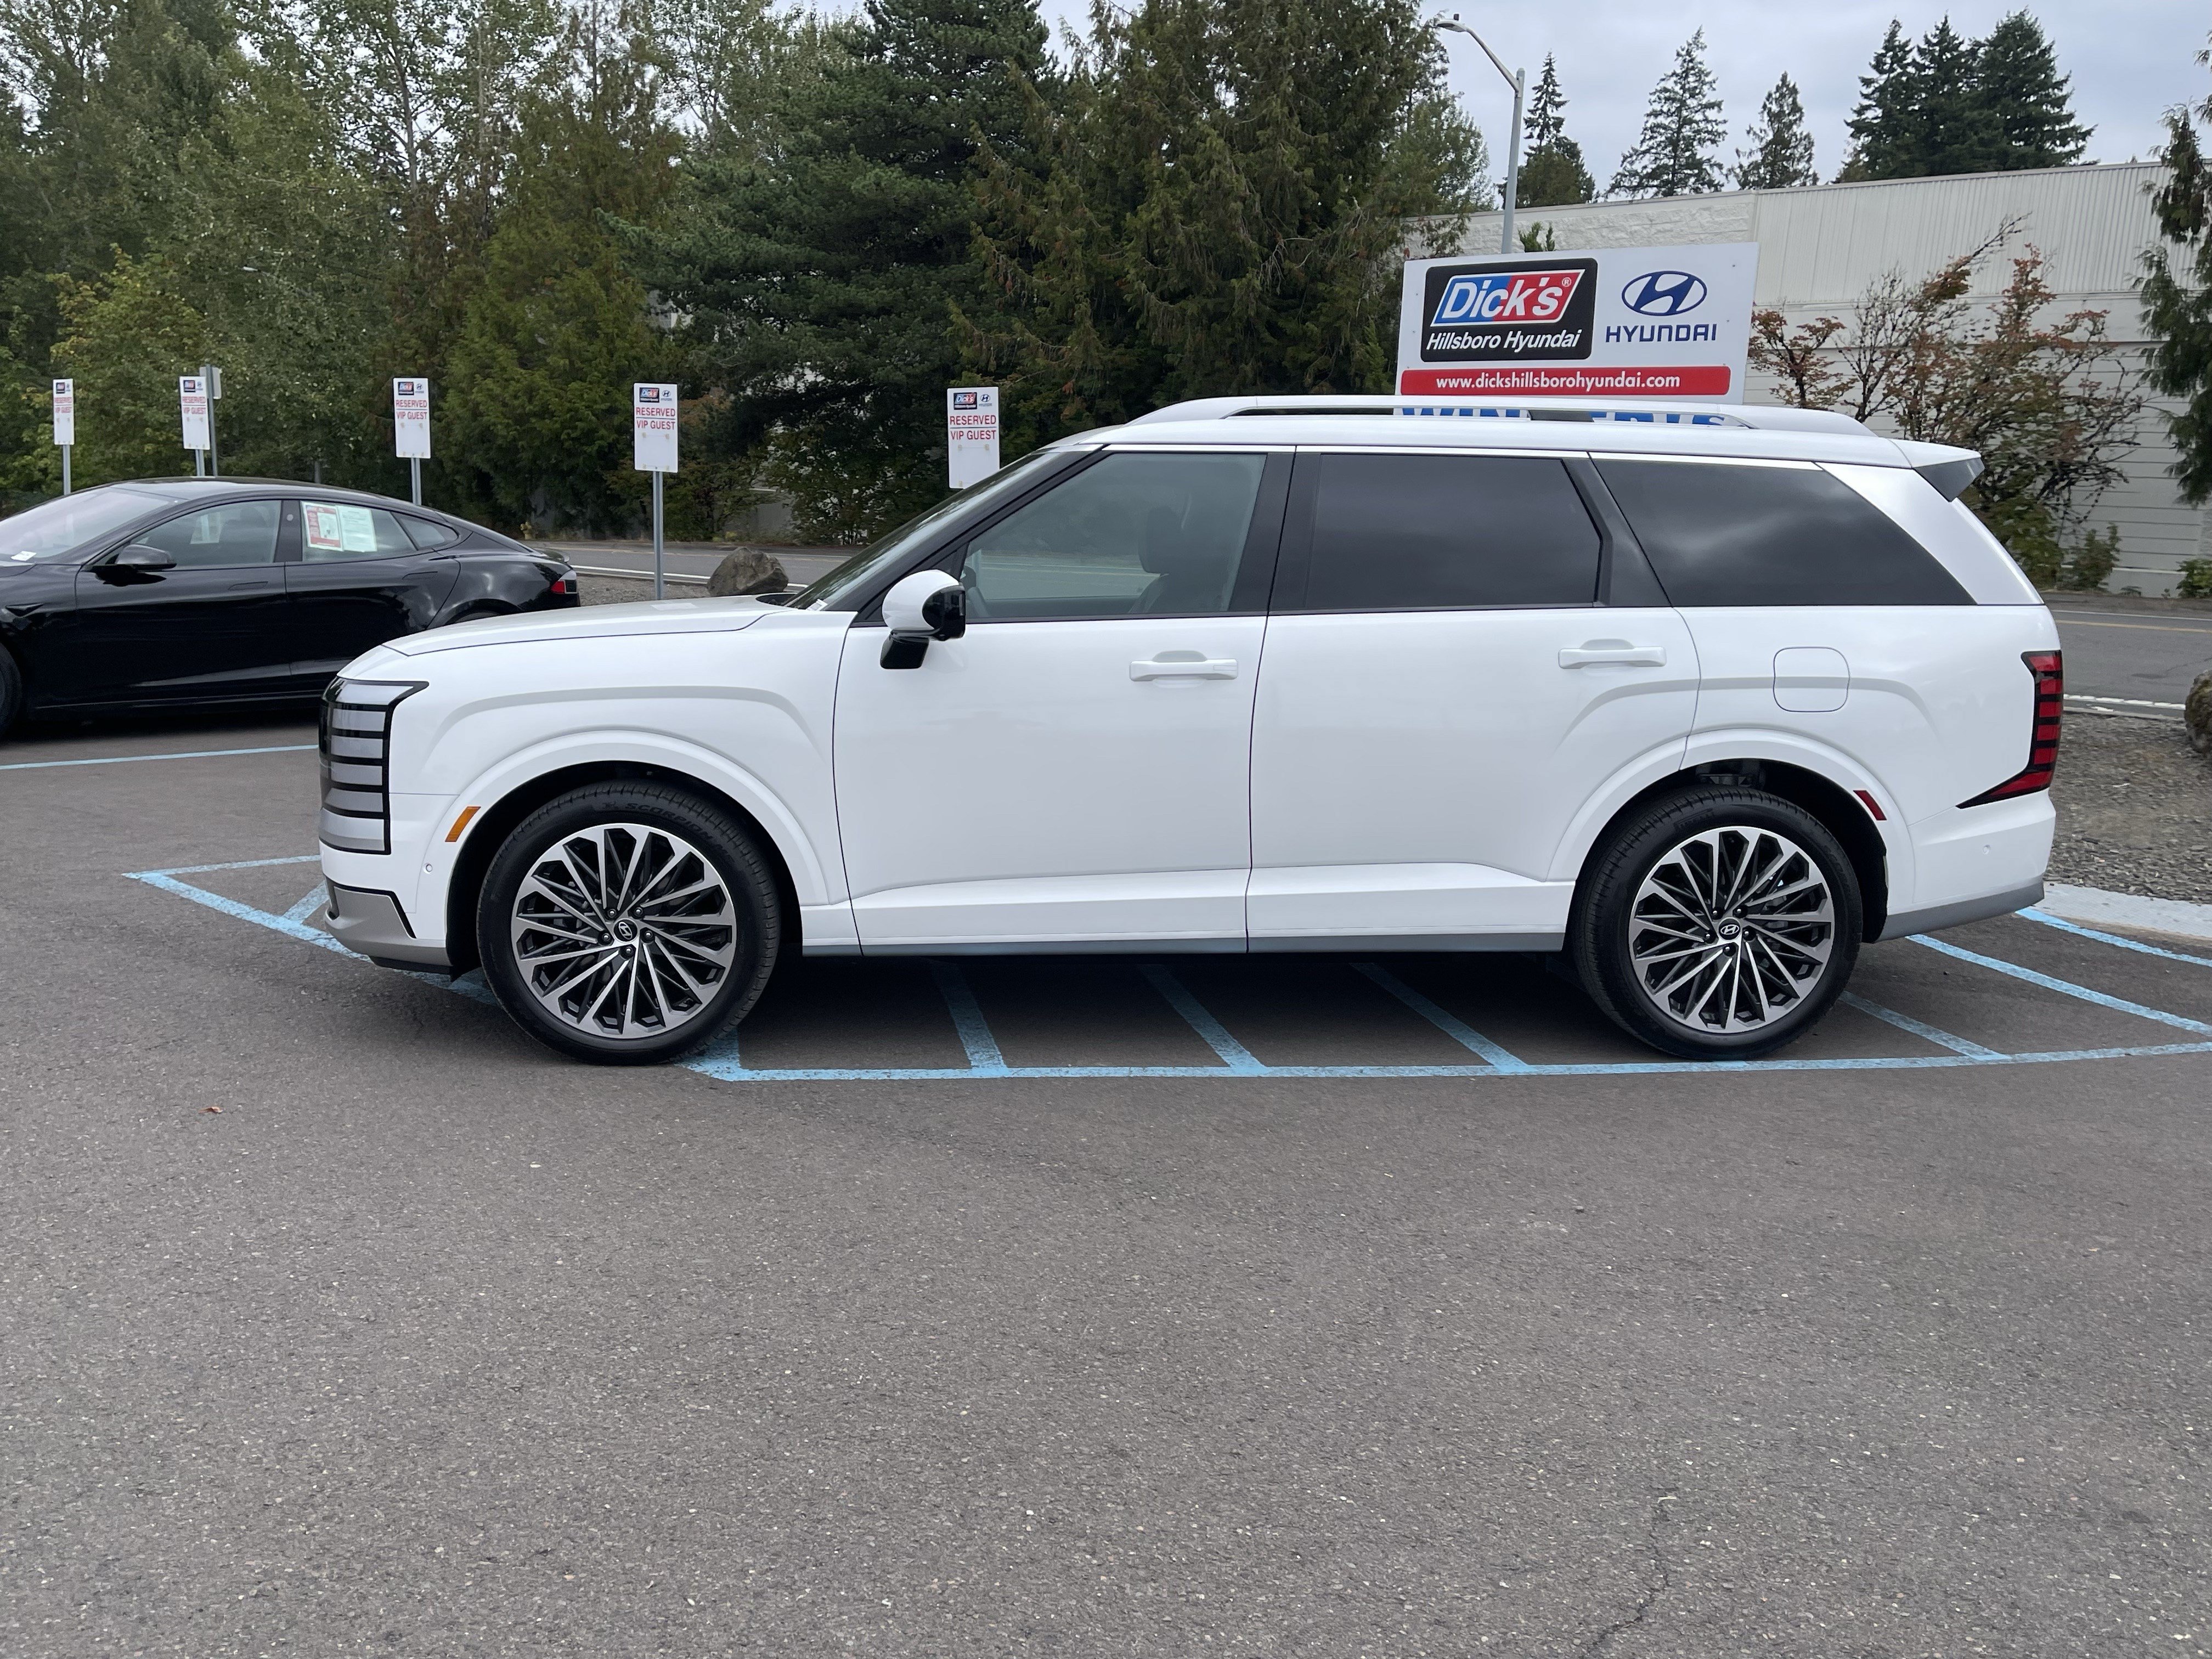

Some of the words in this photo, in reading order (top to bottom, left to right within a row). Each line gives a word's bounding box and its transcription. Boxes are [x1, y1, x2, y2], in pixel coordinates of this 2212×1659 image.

[1606, 324, 1717, 343] HYUNDAI
[1426, 331, 1500, 351] Hillsboro
[1503, 329, 1582, 353] Hyundai
[1436, 372, 1680, 392] www.dickshillsborohyundai.com
[636, 407, 675, 416] RESERVED
[636, 420, 648, 428] VIP
[650, 420, 675, 430] GUEST
[950, 415, 996, 425] RESERVED
[950, 430, 964, 440] VIP
[967, 430, 996, 440] GUEST
